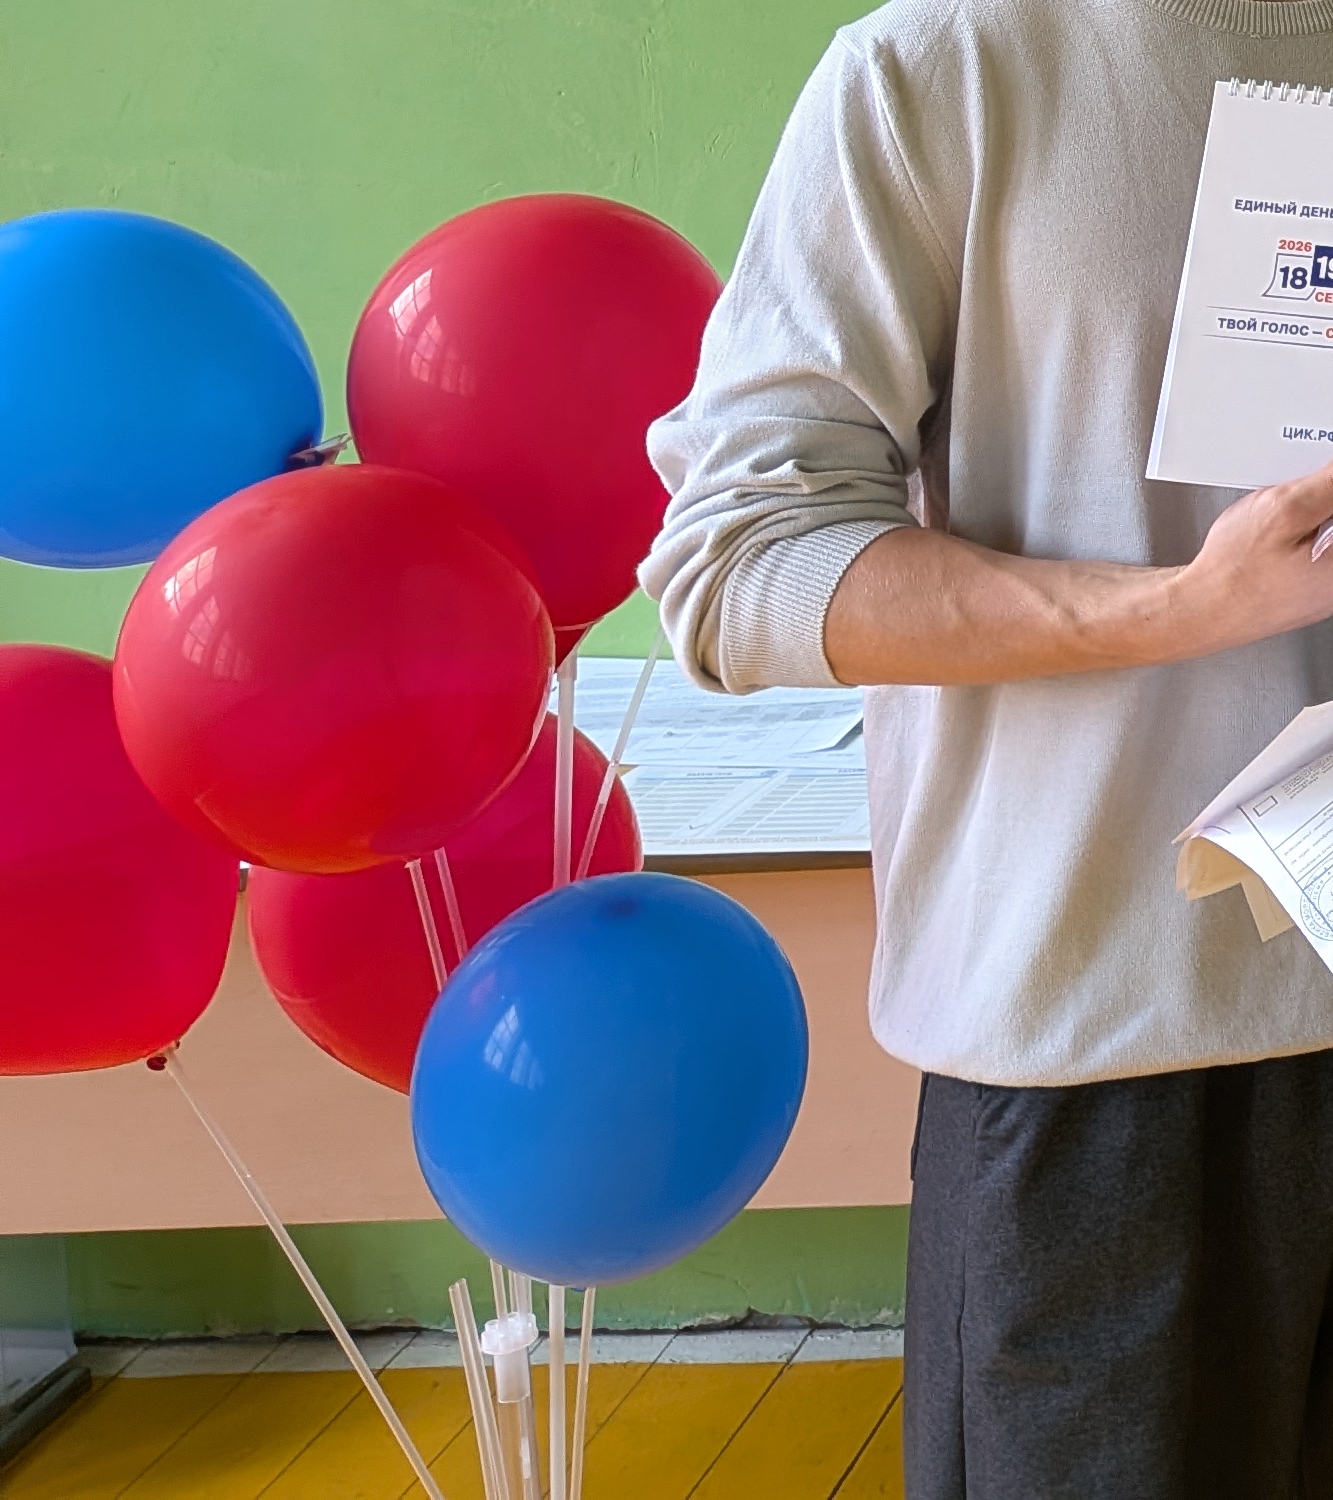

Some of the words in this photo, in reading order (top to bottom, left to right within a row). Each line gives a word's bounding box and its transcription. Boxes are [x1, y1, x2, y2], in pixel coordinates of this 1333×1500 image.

[1235, 199, 1297, 216] ЕДИНЫЙ
[1278, 239, 1312, 252] 2026
[1279, 266, 1307, 289] 18
[1217, 317, 1257, 332] ТВОЙ
[1260, 321, 1309, 336] ГОЛОС
